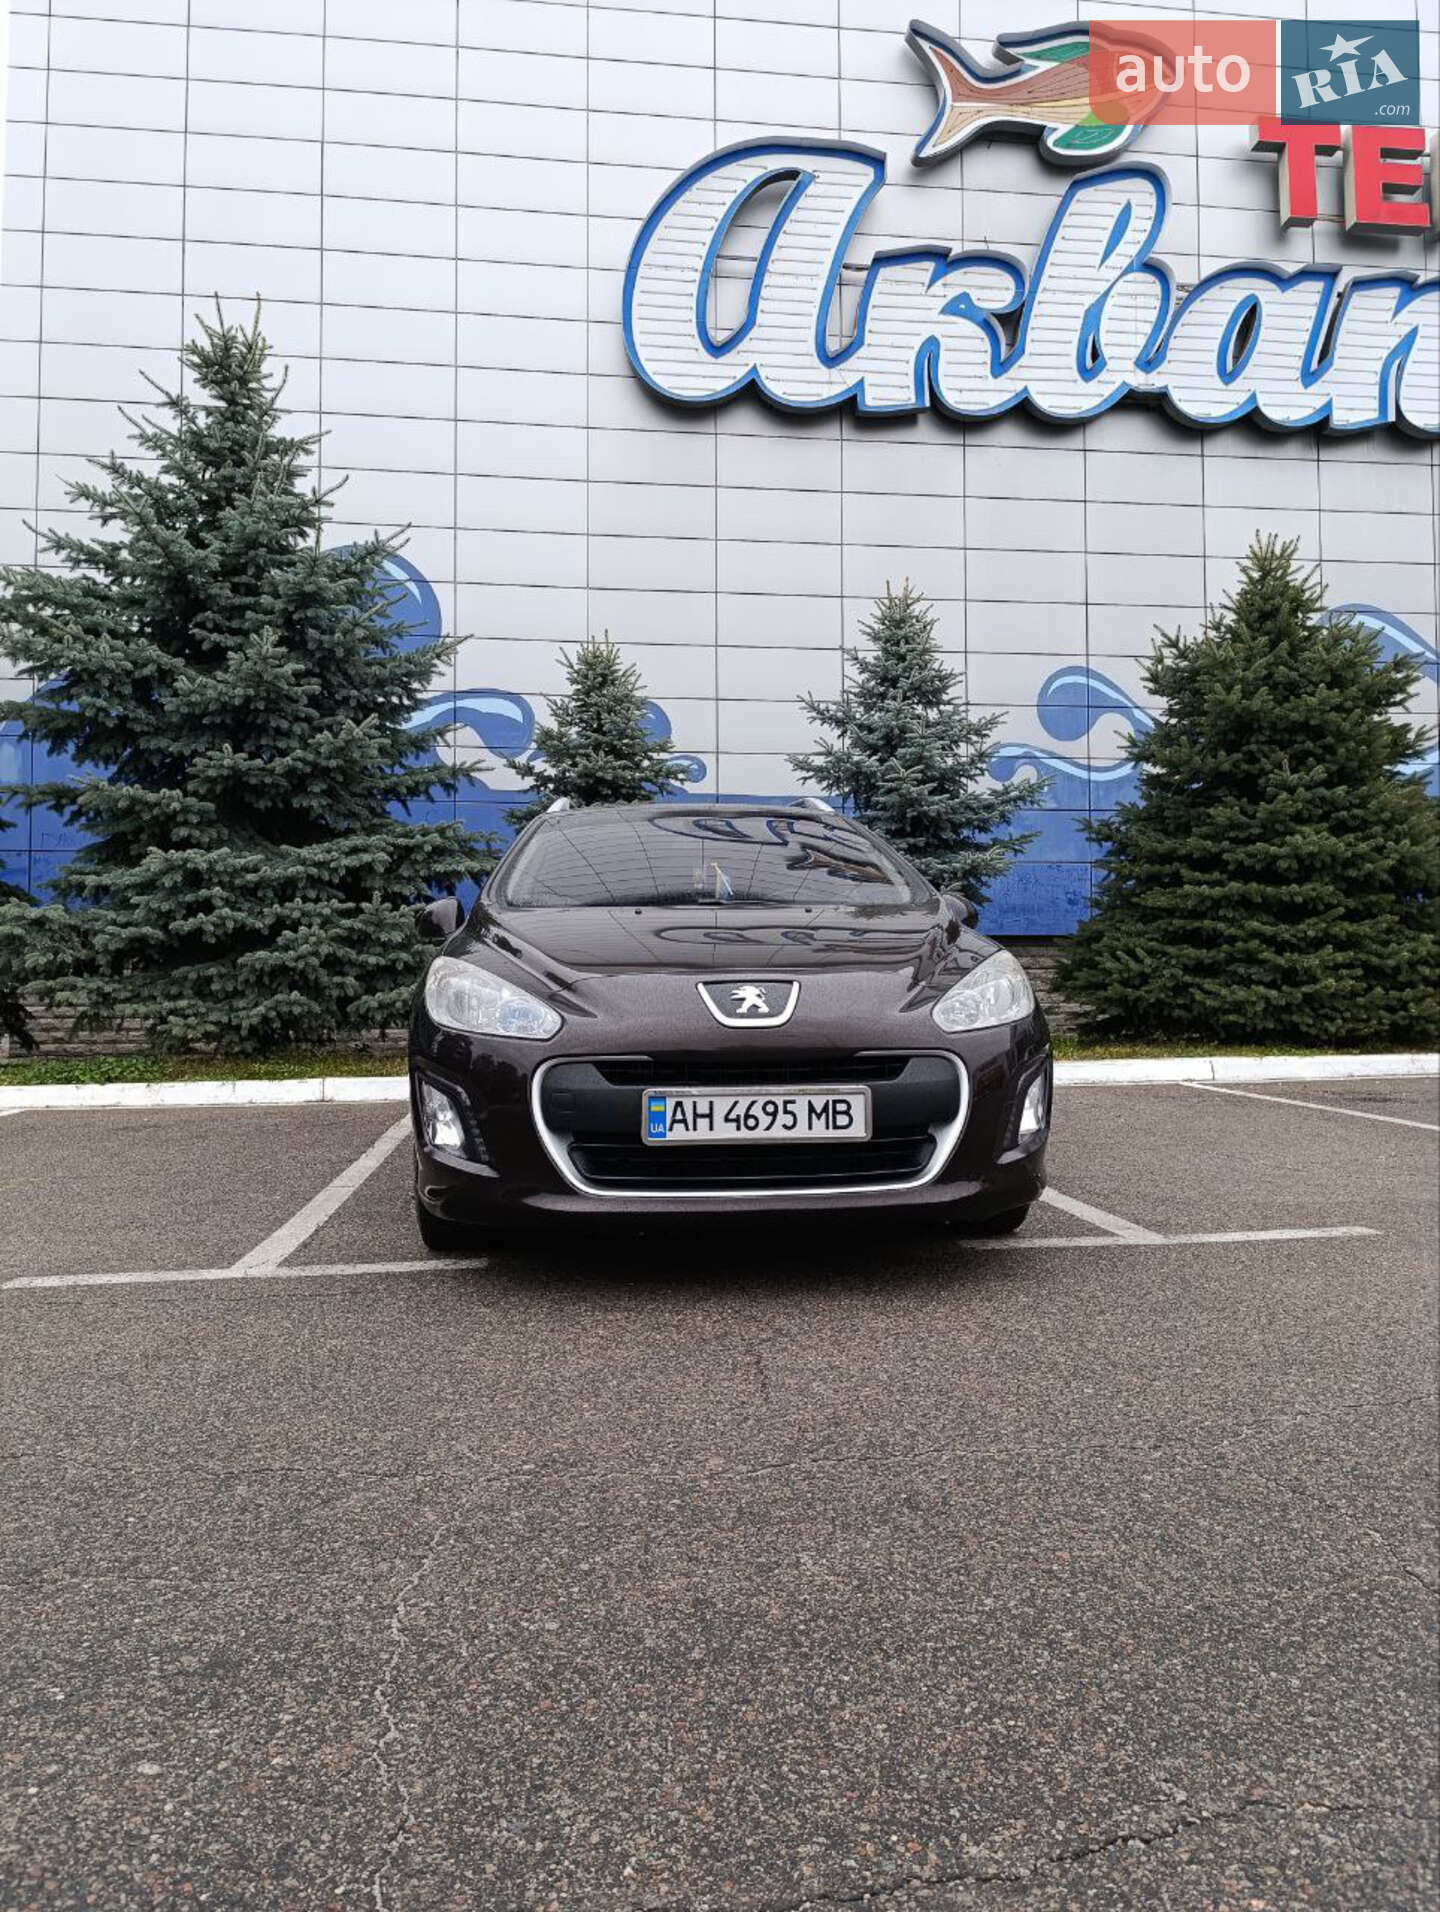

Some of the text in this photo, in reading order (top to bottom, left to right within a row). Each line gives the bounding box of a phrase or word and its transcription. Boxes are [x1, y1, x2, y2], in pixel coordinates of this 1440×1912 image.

[1250, 116, 1440, 234] ТЕ
[651, 1123, 664, 1133] UA
[668, 1099, 854, 1132] AH 4695 MB
